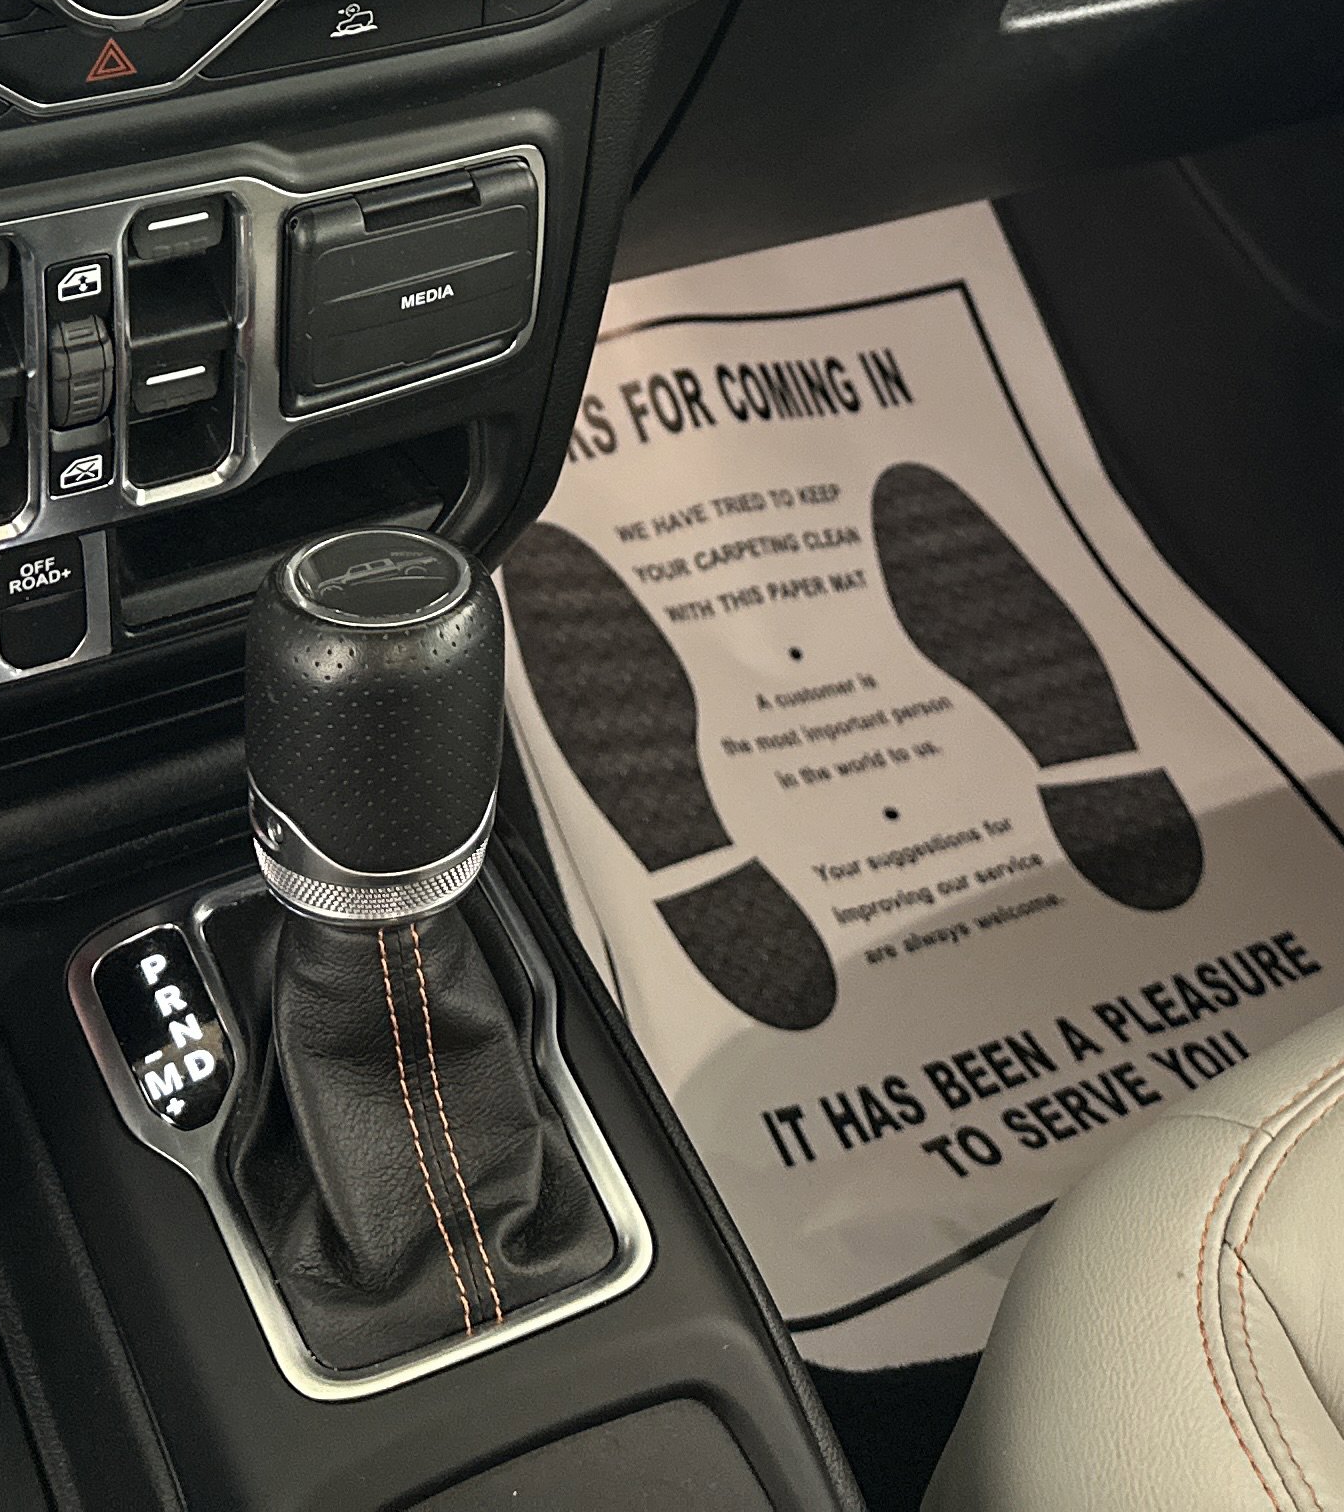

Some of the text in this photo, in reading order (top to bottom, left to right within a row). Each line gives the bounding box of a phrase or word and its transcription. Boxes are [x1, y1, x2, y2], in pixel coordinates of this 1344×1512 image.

[401, 284, 454, 310] MEDIA
[619, 368, 717, 443] FOR
[715, 356, 862, 422] COMING
[859, 348, 912, 409] IN
[614, 483, 840, 543] WE HAVE TRIED TO KEEP
[20, 557, 57, 578] OFF
[632, 526, 862, 583] YOUR CARPETING CLEAN
[9, 567, 72, 595] ROAD+
[663, 568, 867, 623] WITH THIS PAPER MAT
[757, 672, 878, 712] A customer is
[720, 696, 954, 757] the most important person
[774, 769, 799, 789] in
[798, 765, 832, 785] the
[834, 749, 887, 777] world
[886, 747, 911, 765] to
[812, 817, 1013, 882] Your suggestions for
[937, 875, 969, 895] our
[974, 853, 1043, 884] service
[864, 943, 898, 965] are
[903, 922, 971, 953] always
[140, 954, 167, 985] P
[155, 984, 188, 1017] R
[169, 1013, 203, 1049] N
[762, 931, 1323, 1167] IT HAS BEEN A PLEASURE
[144, 1062, 184, 1101] M
[184, 1049, 215, 1082] D
[922, 1029, 1250, 1178] TO SERVE YOU
